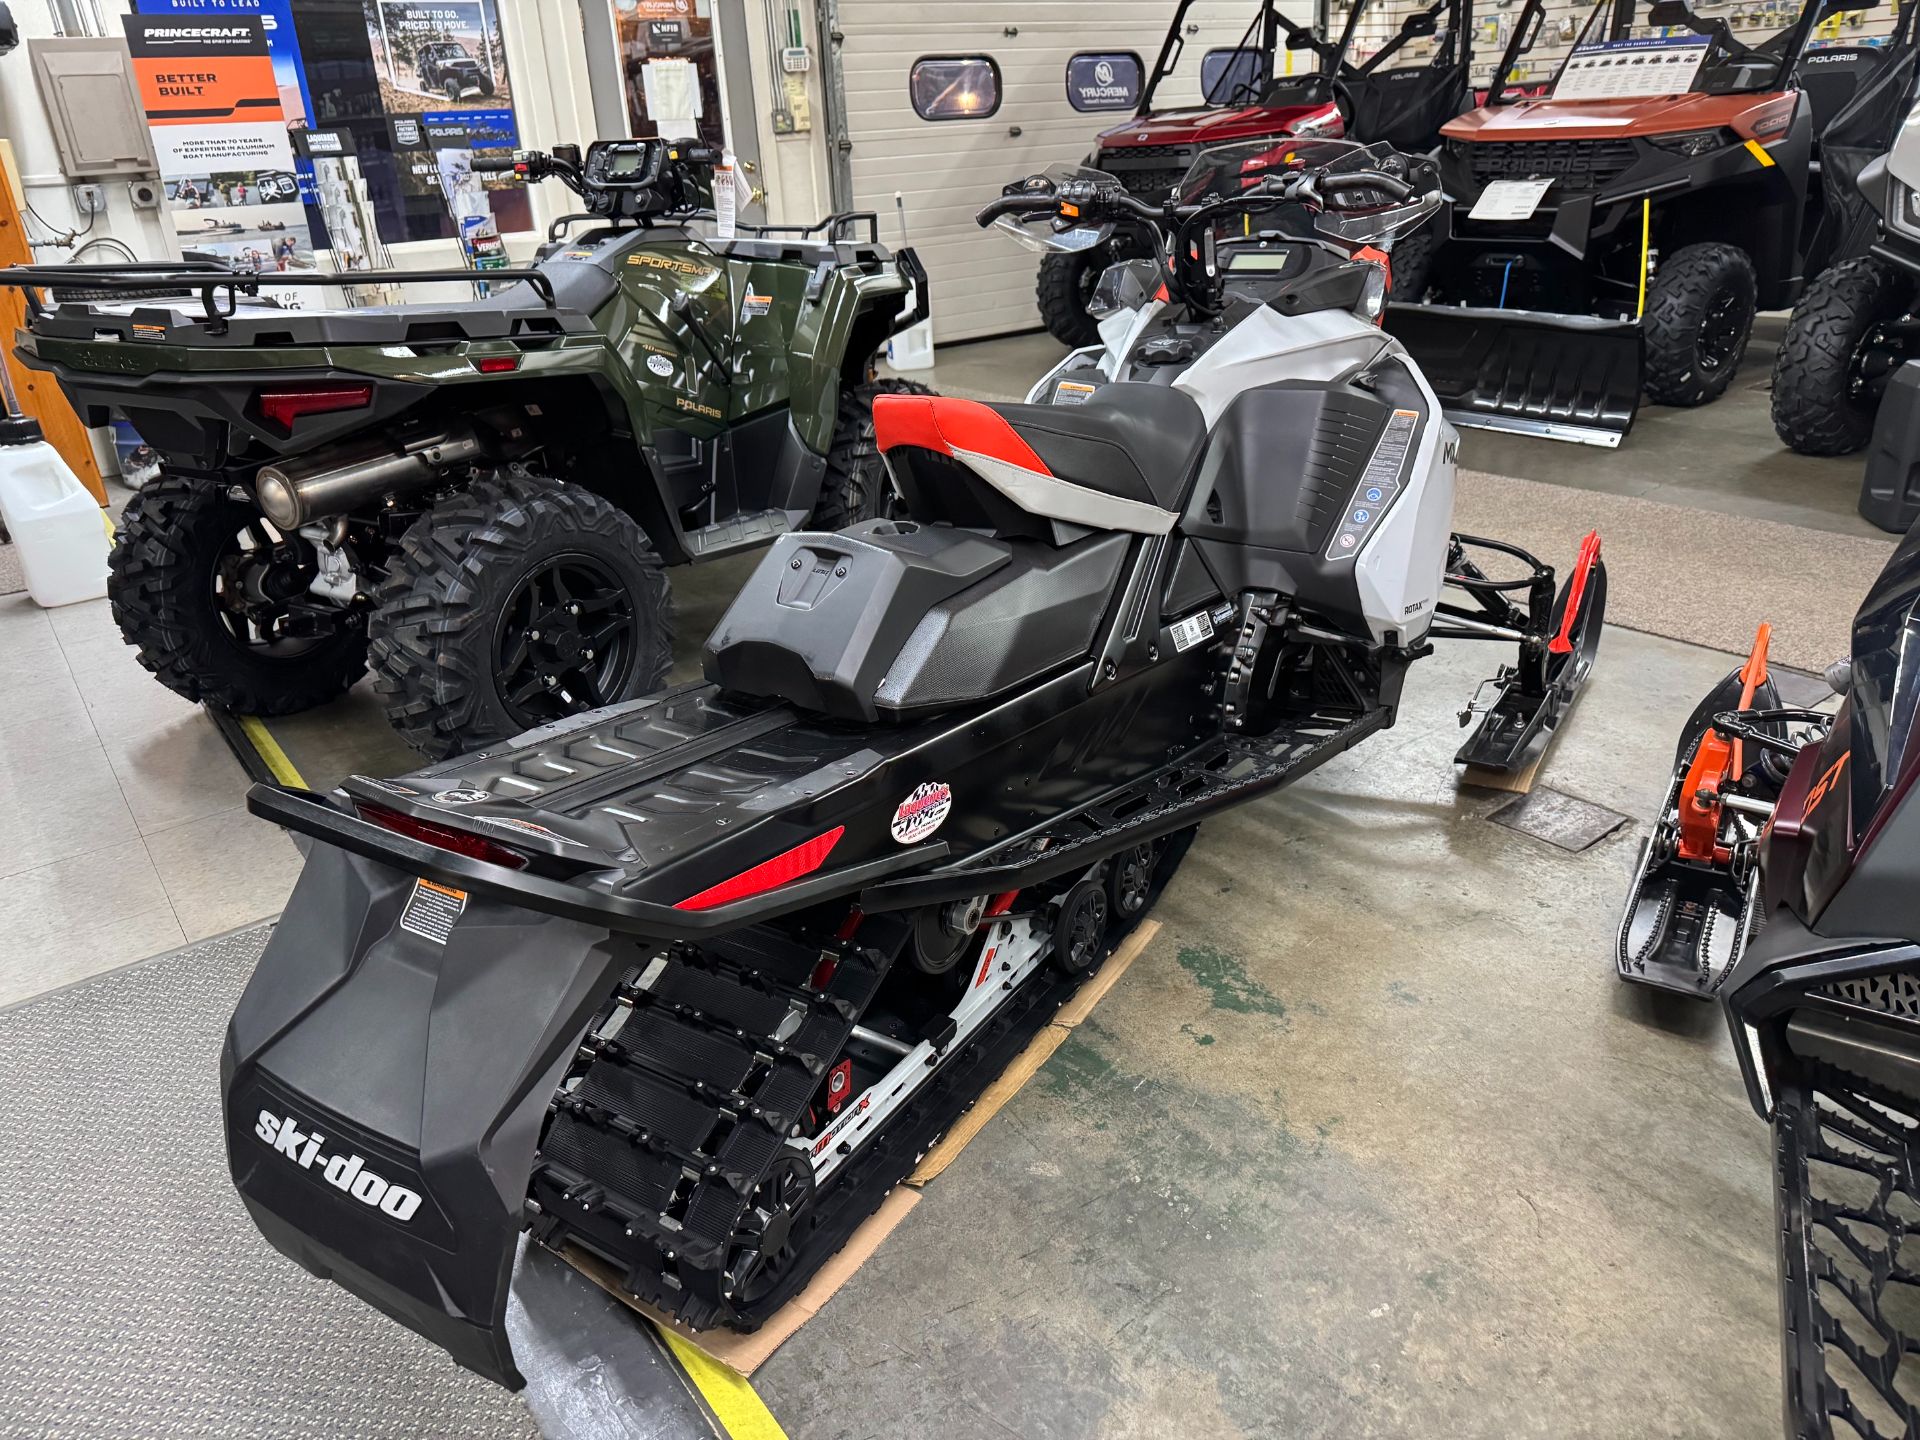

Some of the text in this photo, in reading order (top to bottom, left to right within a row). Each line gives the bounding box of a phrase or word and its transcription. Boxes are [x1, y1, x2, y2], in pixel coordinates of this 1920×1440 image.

[406, 10, 459, 19] BUILT TO GO.
[398, 20, 470, 30] PRICED TO MOVE.
[143, 28, 250, 38] PRINCECRAFT
[1807, 53, 1858, 64] POLARIS
[155, 73, 217, 84] BETTER
[158, 86, 204, 96] BUILT
[429, 127, 464, 137] POLARIS
[236, 143, 275, 151] ALUMINUM
[1488, 156, 1590, 173] POLARIS
[627, 254, 714, 277] SPORTSMA
[284, 292, 298, 301] OF
[676, 397, 722, 418] POLARIS
[1404, 601, 1423, 615] ROTAX
[255, 1109, 422, 1221] ski-doo
